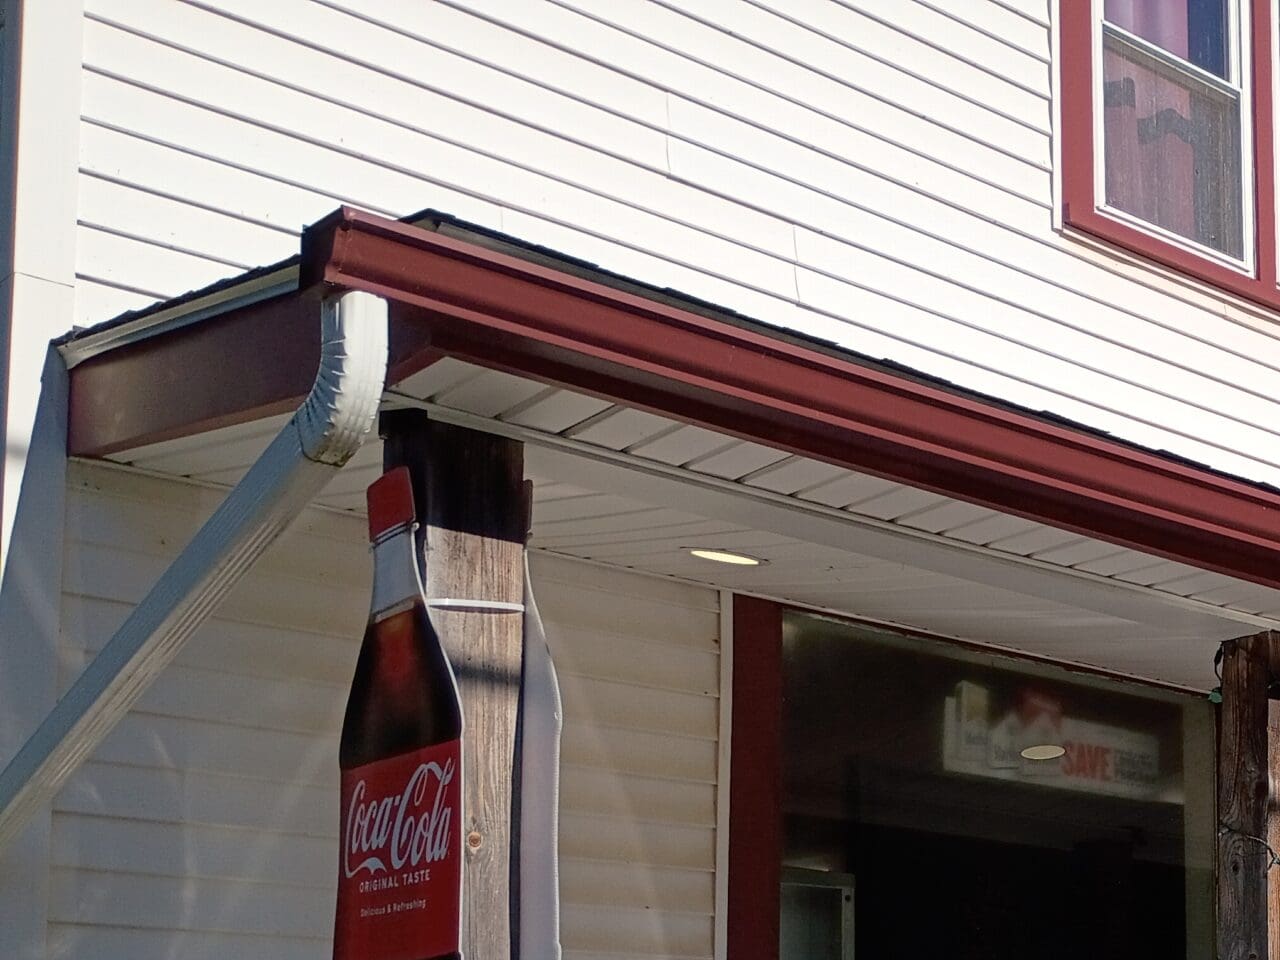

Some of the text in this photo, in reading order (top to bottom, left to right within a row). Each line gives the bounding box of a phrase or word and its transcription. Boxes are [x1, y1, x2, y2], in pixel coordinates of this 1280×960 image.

[1062, 740, 1112, 781] SAVE
[345, 757, 456, 878] Coca-Cola
[360, 869, 431, 893] ORIGINAL TASTE
[361, 905, 386, 917] Delicious
[393, 899, 427, 913] Refreshing
